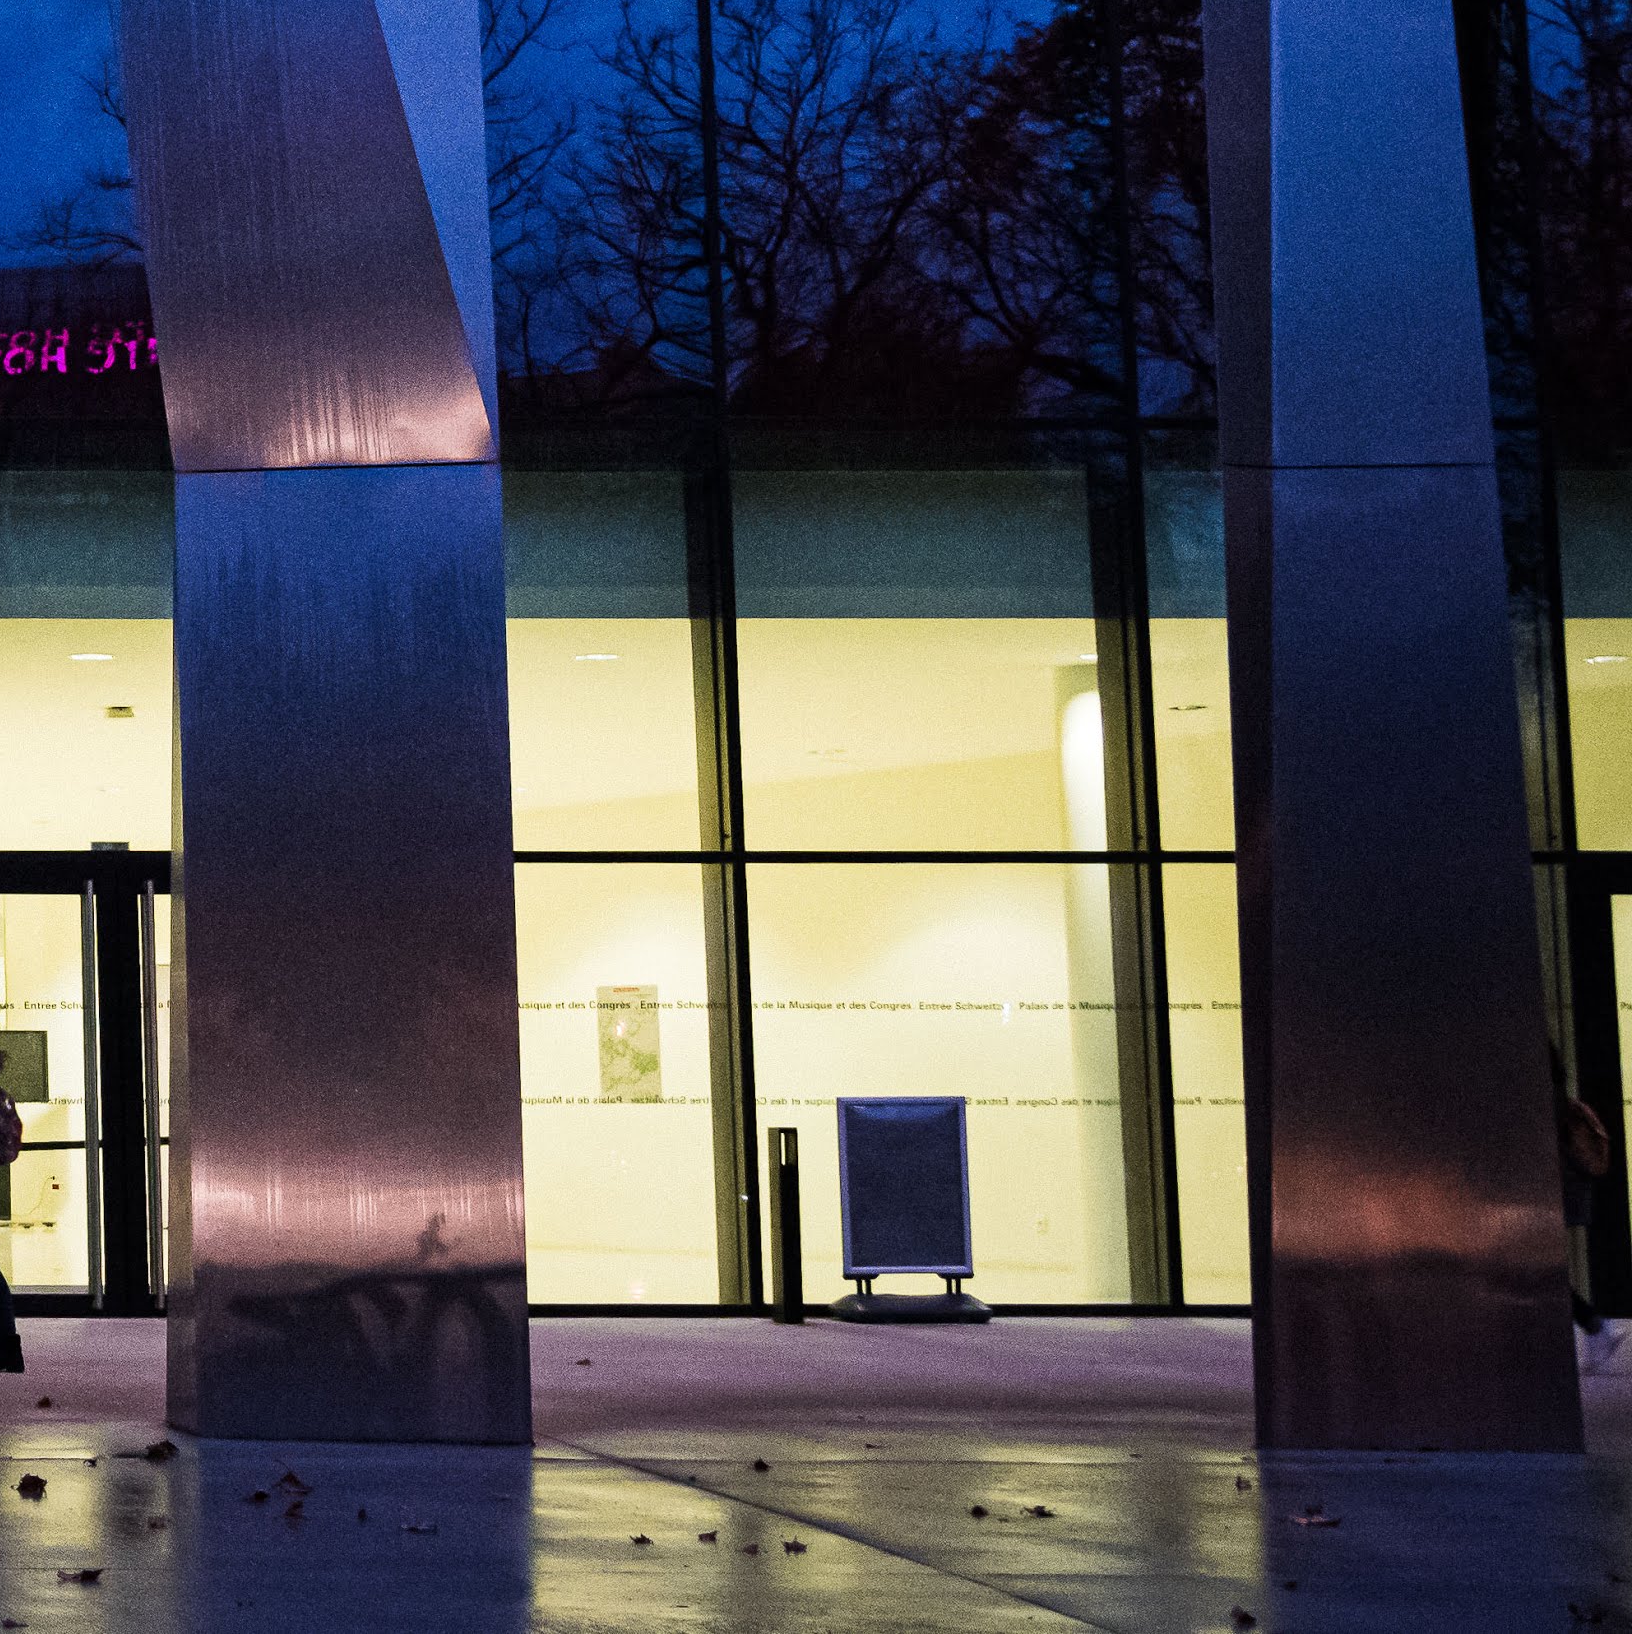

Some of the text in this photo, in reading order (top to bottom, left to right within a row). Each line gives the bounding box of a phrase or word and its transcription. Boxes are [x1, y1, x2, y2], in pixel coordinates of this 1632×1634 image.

[555, 1001, 565, 1010] et
[568, 1001, 586, 1010] des
[761, 1001, 774, 1010] de
[776, 1001, 786, 1010] la
[788, 1001, 833, 1012] Musique
[837, 1002, 846, 1010] et
[849, 1001, 867, 1010] des
